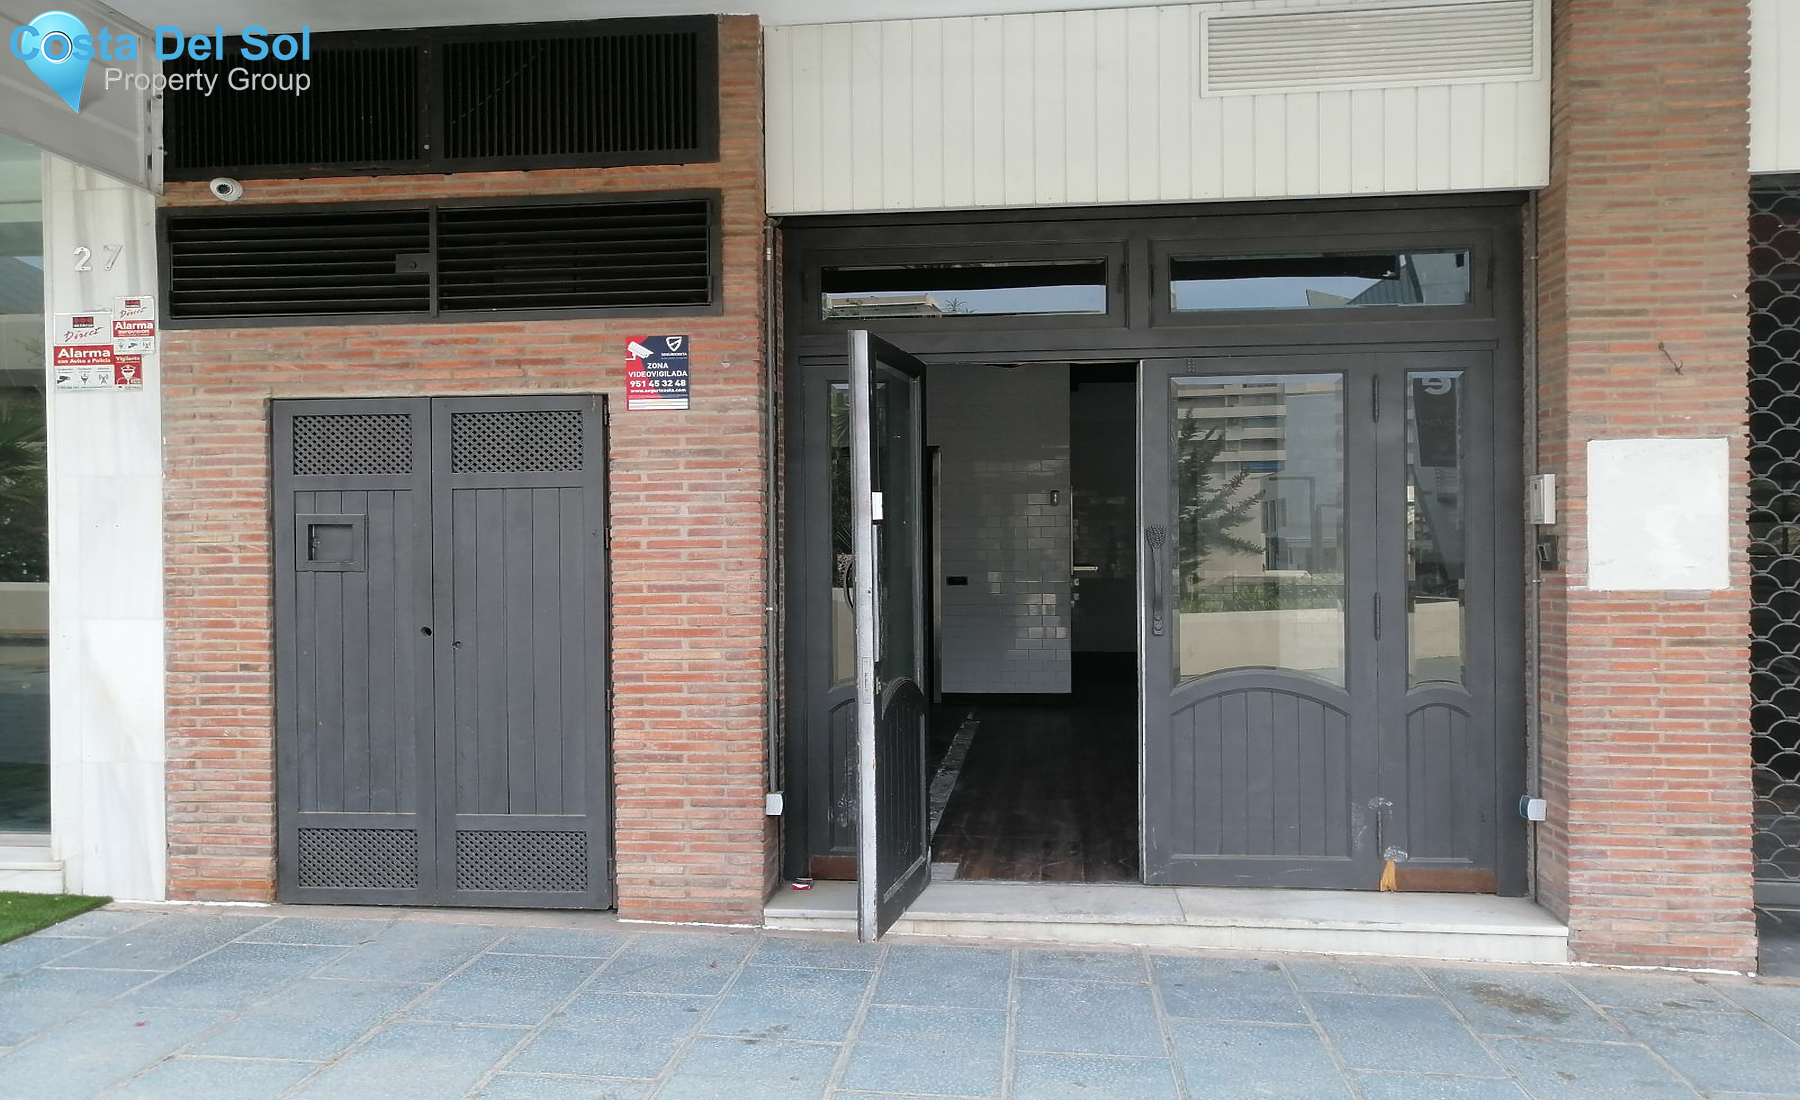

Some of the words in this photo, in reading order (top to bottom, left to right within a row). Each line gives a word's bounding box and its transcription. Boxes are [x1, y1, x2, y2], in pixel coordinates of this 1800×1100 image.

[115, 321, 154, 330] Alarma
[64, 326, 104, 342] Direct
[58, 347, 111, 358] Alarma
[630, 380, 646, 388] 951
[661, 379, 673, 387] 32
[674, 379, 686, 387] 48
